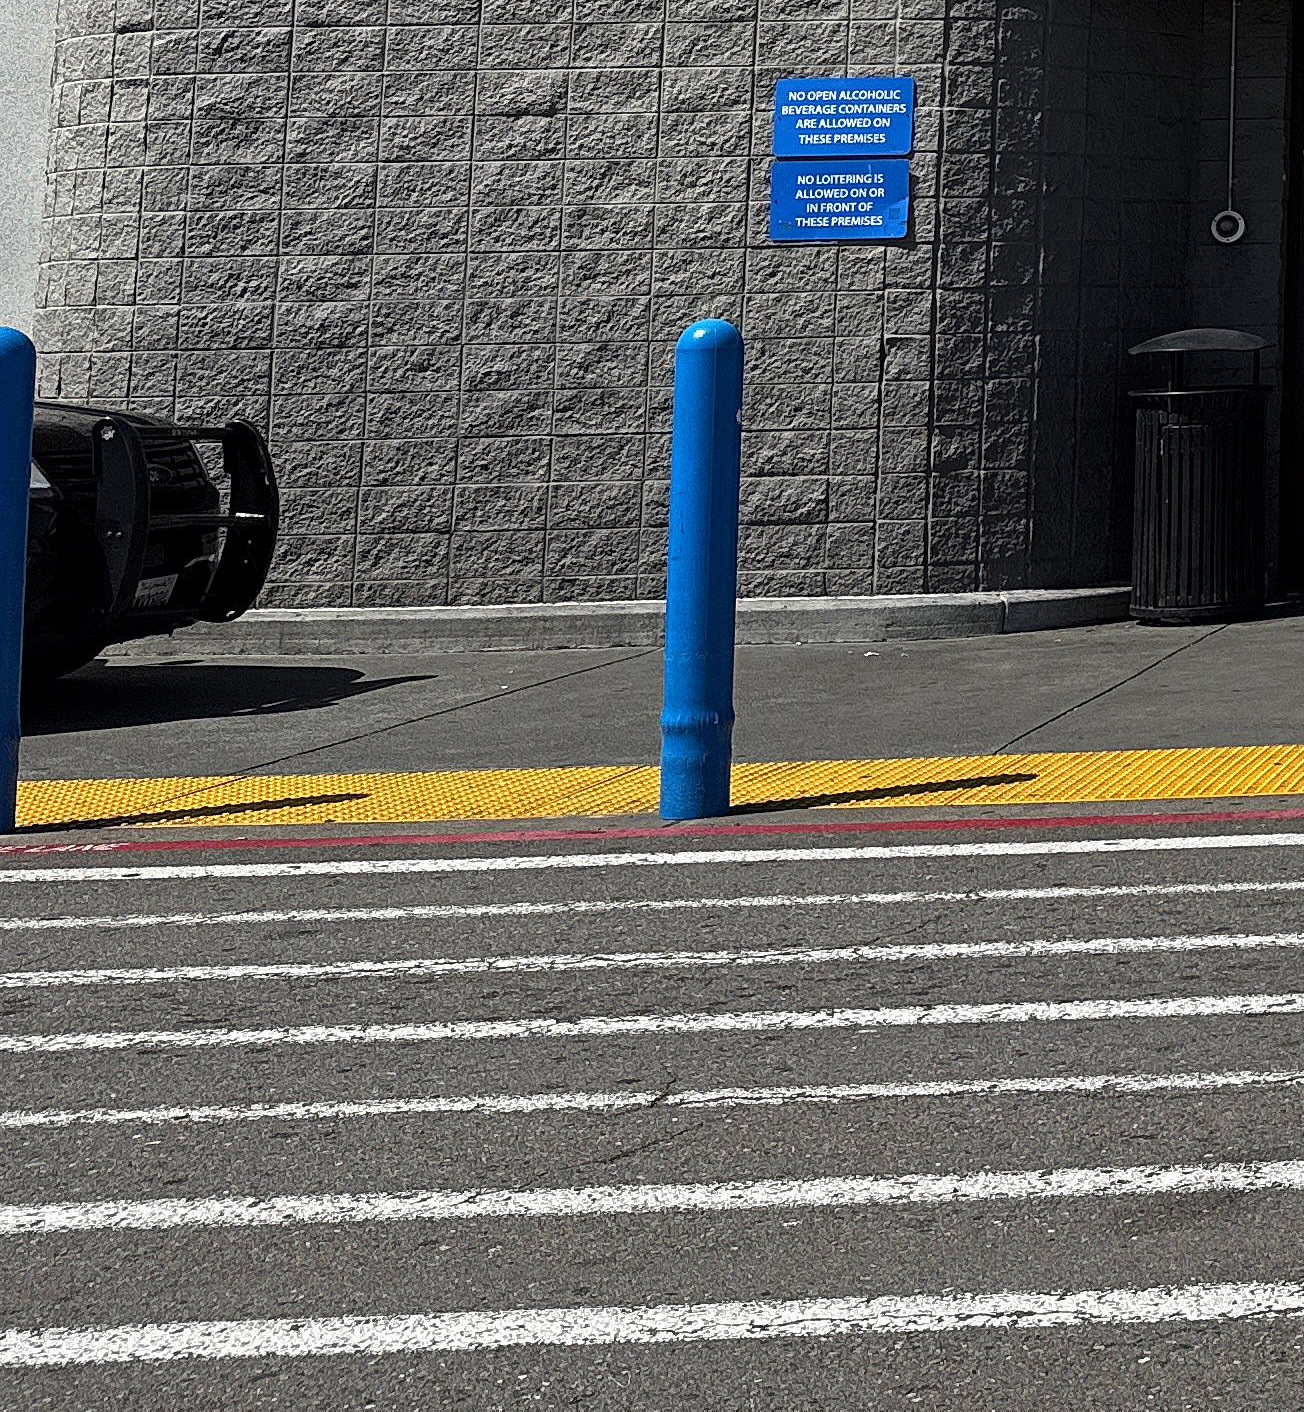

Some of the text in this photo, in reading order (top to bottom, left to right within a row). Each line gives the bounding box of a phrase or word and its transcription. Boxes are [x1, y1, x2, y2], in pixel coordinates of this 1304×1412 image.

[788, 89, 901, 101] NO OPEN ALCOHOLIC
[781, 103, 907, 115] BEVERAGE CONTAINERS
[795, 118, 891, 129] ARE ALLOWED ON
[798, 133, 887, 145] THESE PREMISES
[797, 173, 884, 185] NO LOITERING IS
[795, 188, 885, 199] ALLOWED ON OR
[806, 202, 873, 213] IN FRONT OF
[795, 216, 883, 227] THESE PREMISES
